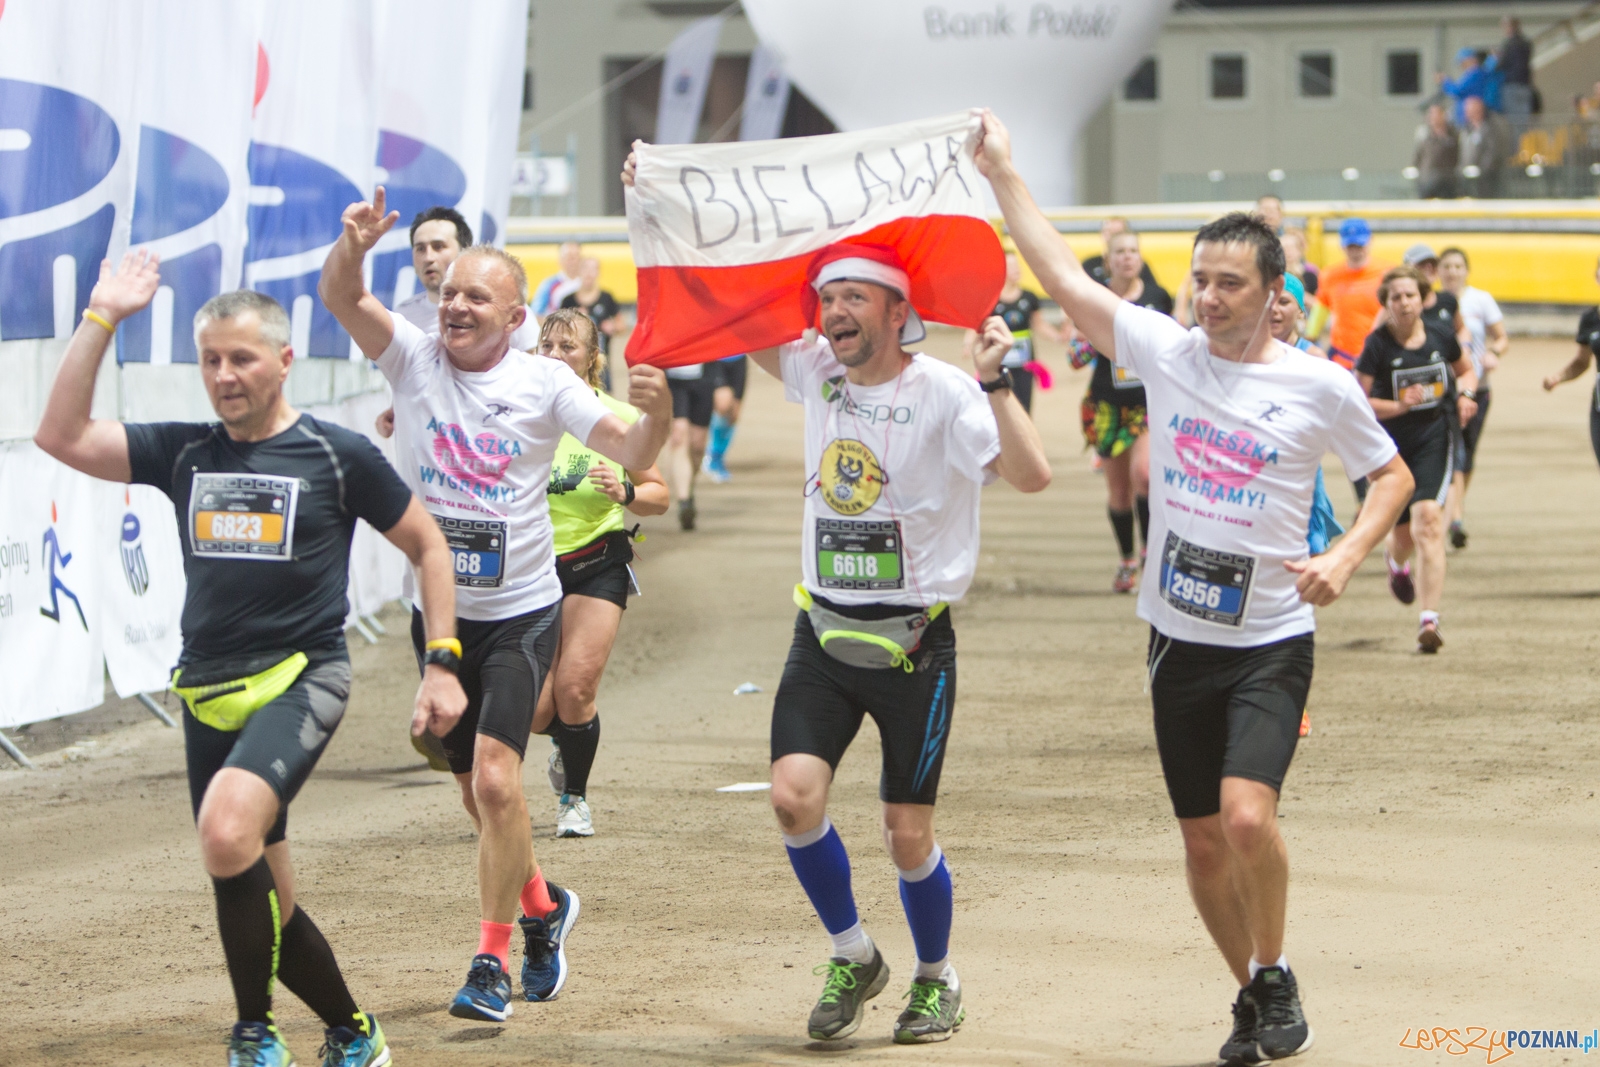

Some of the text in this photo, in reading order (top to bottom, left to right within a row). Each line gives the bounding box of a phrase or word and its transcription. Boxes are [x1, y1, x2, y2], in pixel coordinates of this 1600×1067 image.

[924, 5, 1015, 38] Bank
[680, 136, 972, 249] BIELAWA
[1168, 413, 1278, 465] AGNIESZKA
[420, 465, 517, 503] WYGRAMY!
[1164, 466, 1266, 510] WYGRAMY!
[211, 513, 263, 540] 6823
[0, 535, 29, 575] ajmy
[833, 553, 878, 577] 6618
[1171, 572, 1223, 609] 2956
